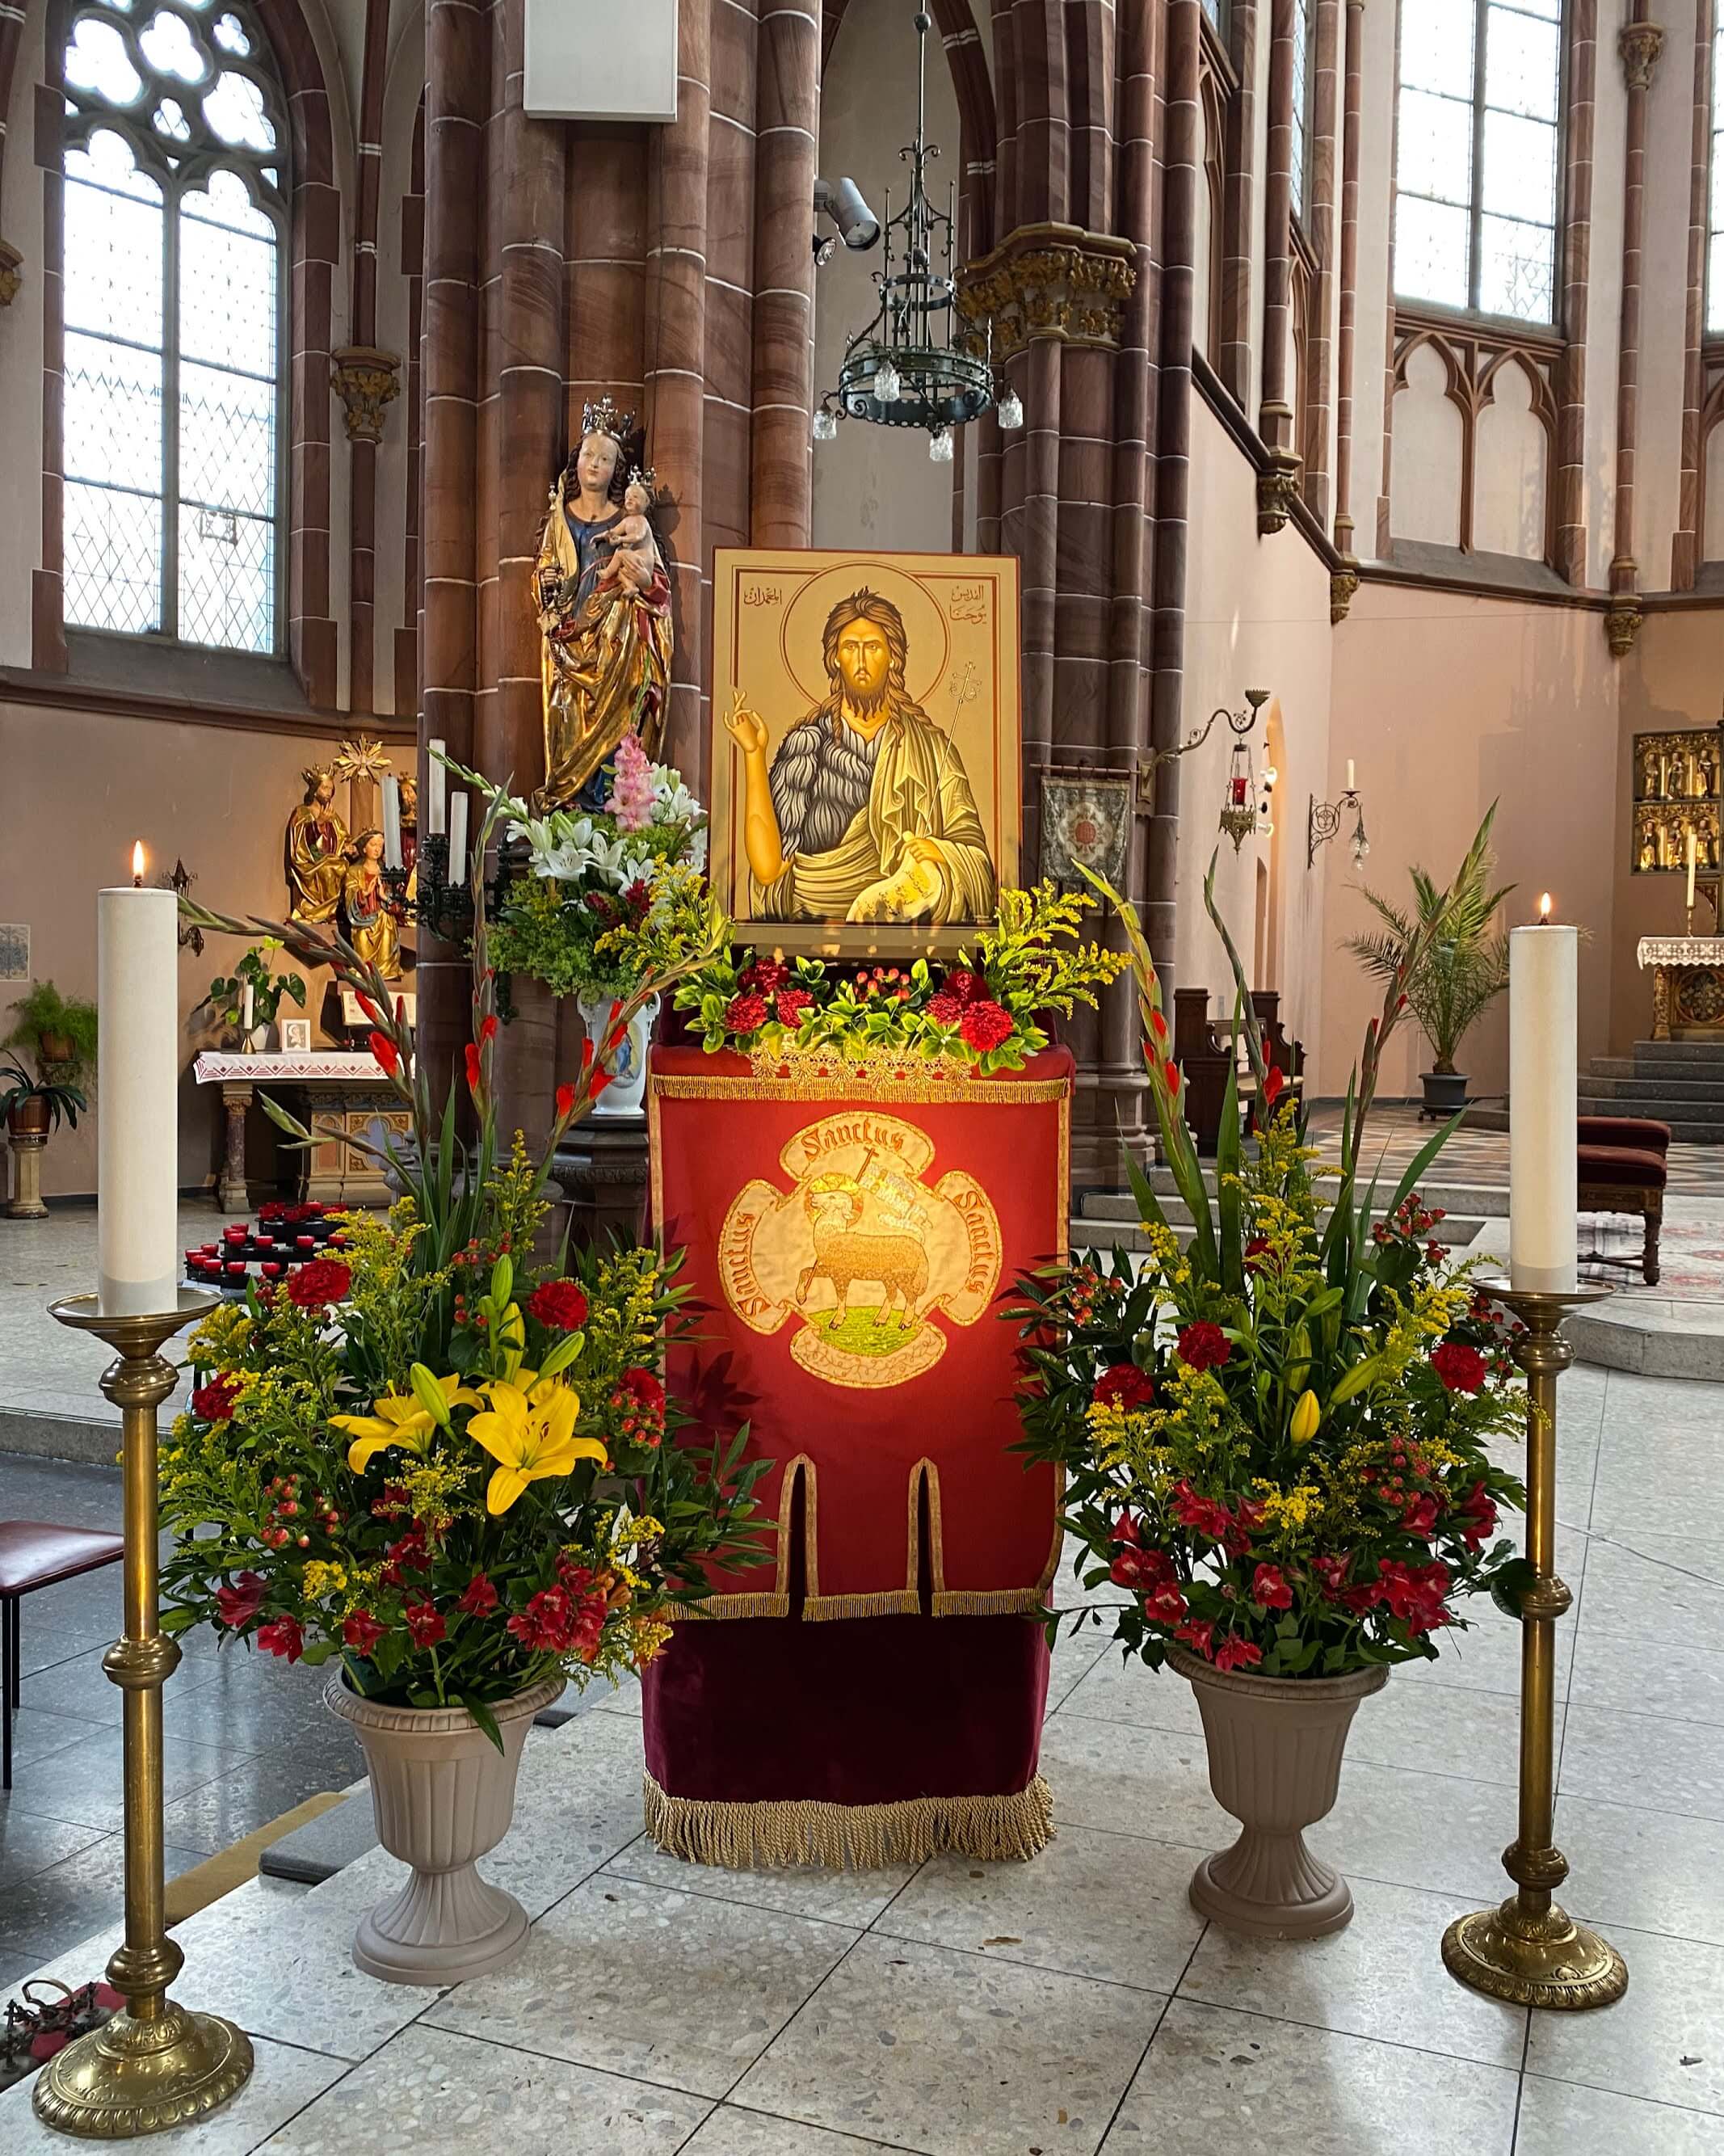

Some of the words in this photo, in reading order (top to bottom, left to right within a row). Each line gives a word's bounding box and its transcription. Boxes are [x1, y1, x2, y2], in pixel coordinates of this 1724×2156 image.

[801, 1117, 906, 1161] Sanctus
[724, 1211, 772, 1316] Sanctus
[953, 1190, 995, 1295] Sanctus
